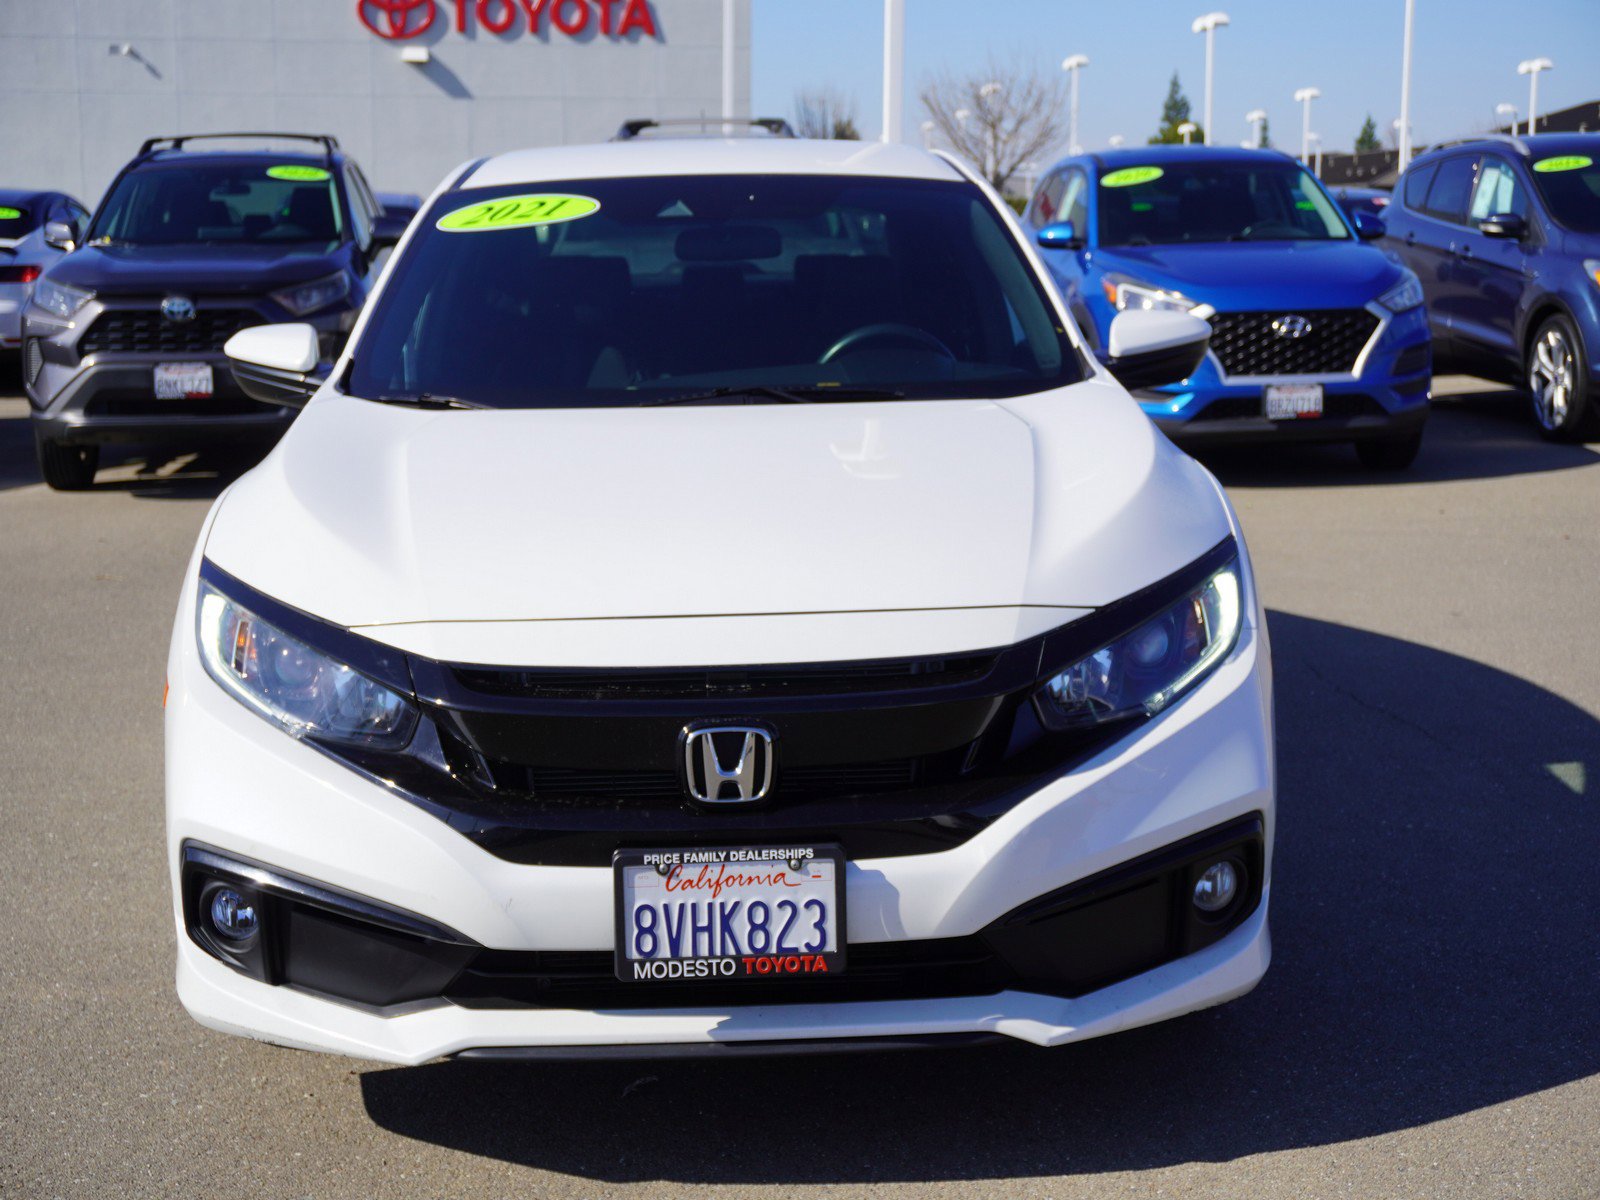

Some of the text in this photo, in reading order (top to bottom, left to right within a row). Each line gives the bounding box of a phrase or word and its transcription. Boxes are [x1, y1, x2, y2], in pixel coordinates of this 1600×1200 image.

[451, 0, 655, 35] TOYOTA
[459, 198, 572, 227] 2021
[644, 848, 814, 865] PRICE FAMILY DEALERSHIPS
[665, 864, 801, 898] California
[634, 899, 827, 959] 8VHK823
[634, 955, 828, 980] MODESTO TOYOTA
